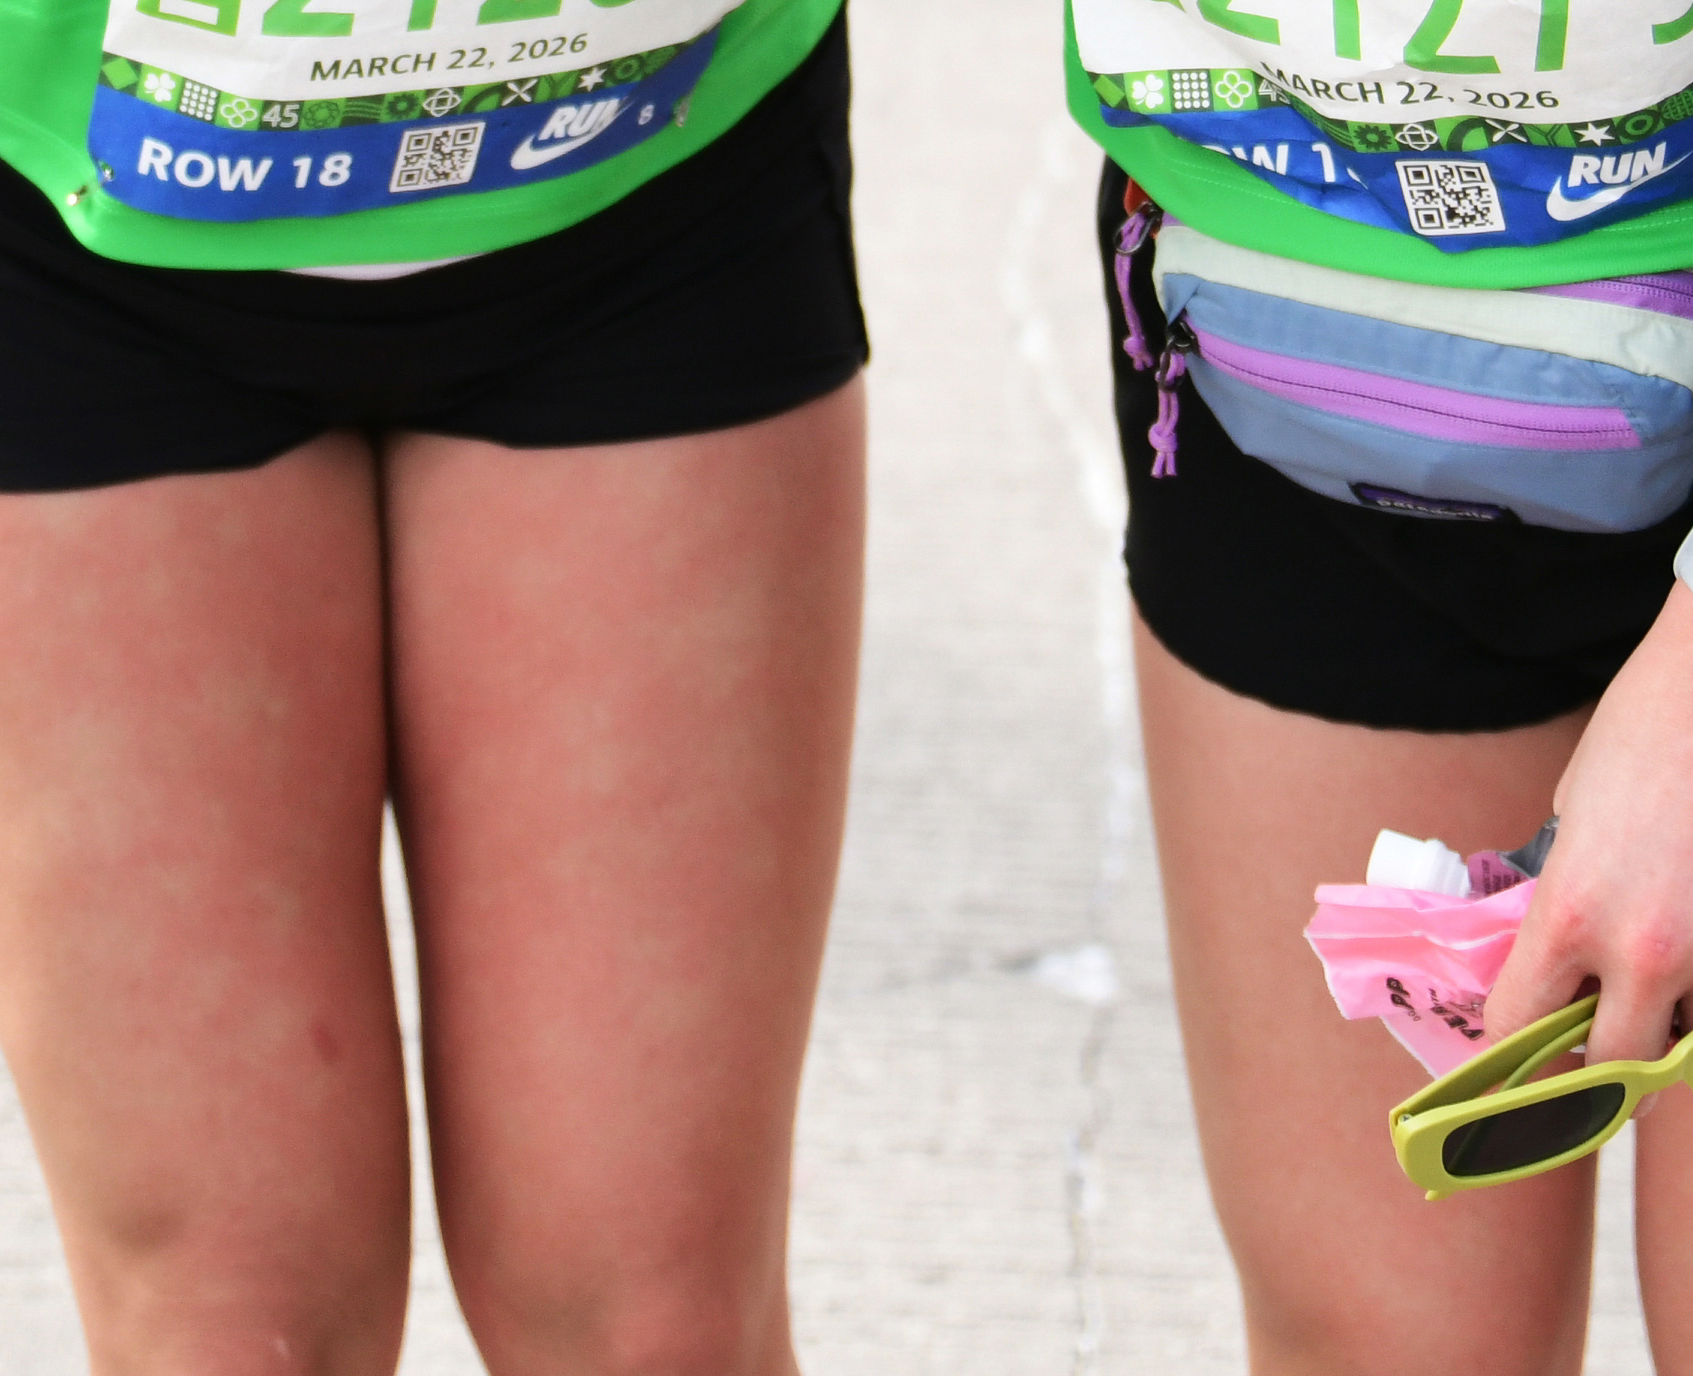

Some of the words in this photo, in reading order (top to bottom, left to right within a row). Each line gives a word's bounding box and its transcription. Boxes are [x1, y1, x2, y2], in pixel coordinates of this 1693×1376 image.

[310, 51, 437, 82] MARCH
[446, 47, 495, 71] 22,
[506, 32, 588, 64] 2026
[1260, 61, 1384, 104] MARCH
[1396, 81, 1454, 103] 22,
[1463, 89, 1559, 109] 2026
[262, 104, 299, 128] 45
[137, 137, 273, 191] ROW
[292, 153, 352, 189] 18
[1568, 141, 1667, 188] RUN
